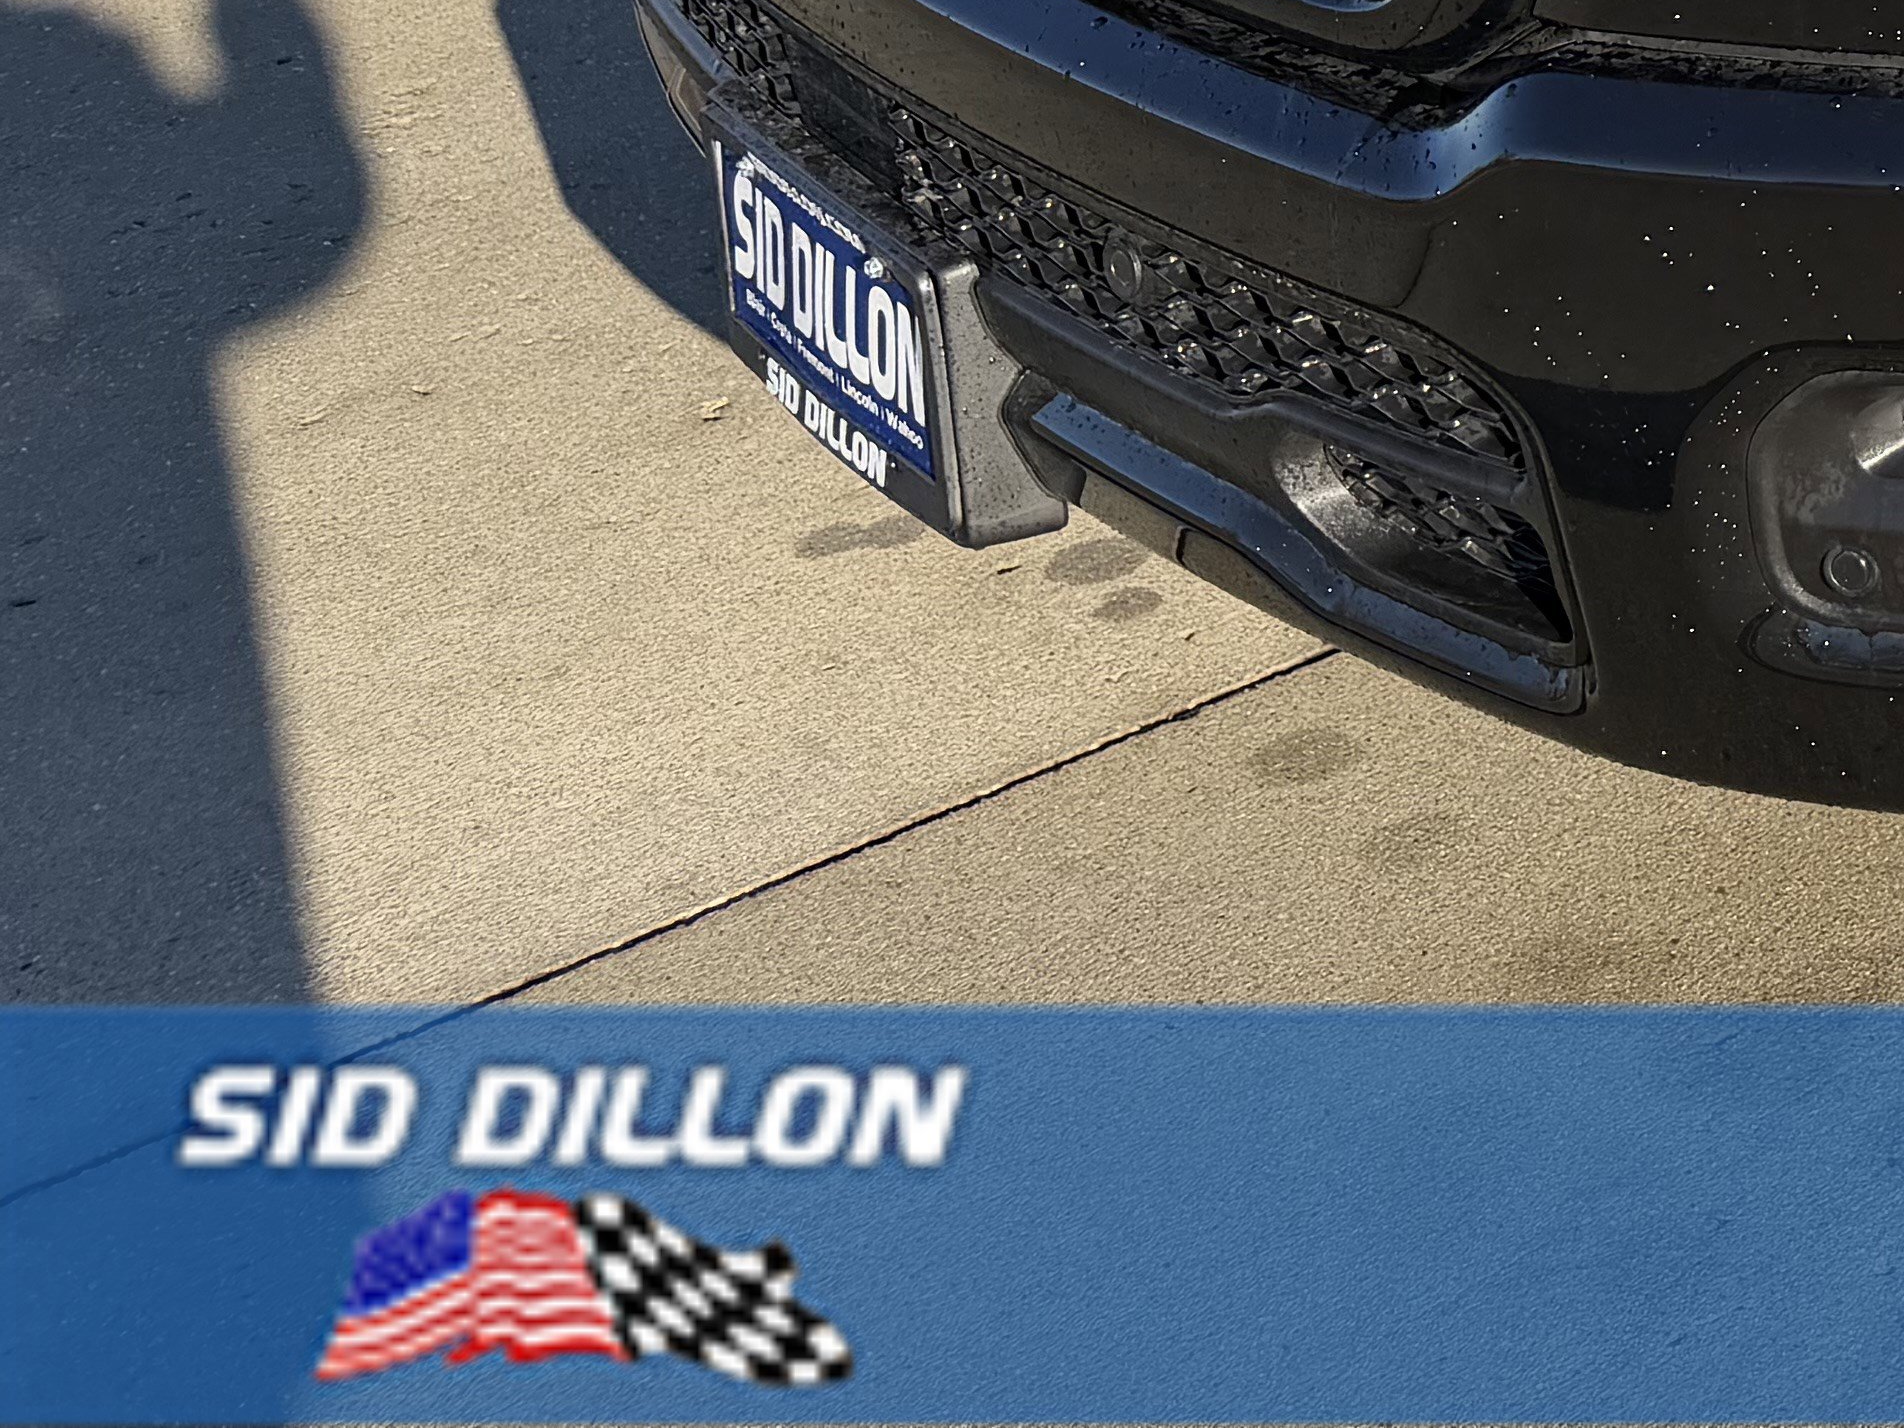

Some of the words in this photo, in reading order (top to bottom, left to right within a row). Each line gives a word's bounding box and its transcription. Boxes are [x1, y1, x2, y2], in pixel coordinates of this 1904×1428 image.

[733, 172, 786, 311] SID
[791, 221, 926, 428] DILLON
[765, 356, 800, 415] SID
[804, 389, 888, 488] DILLON
